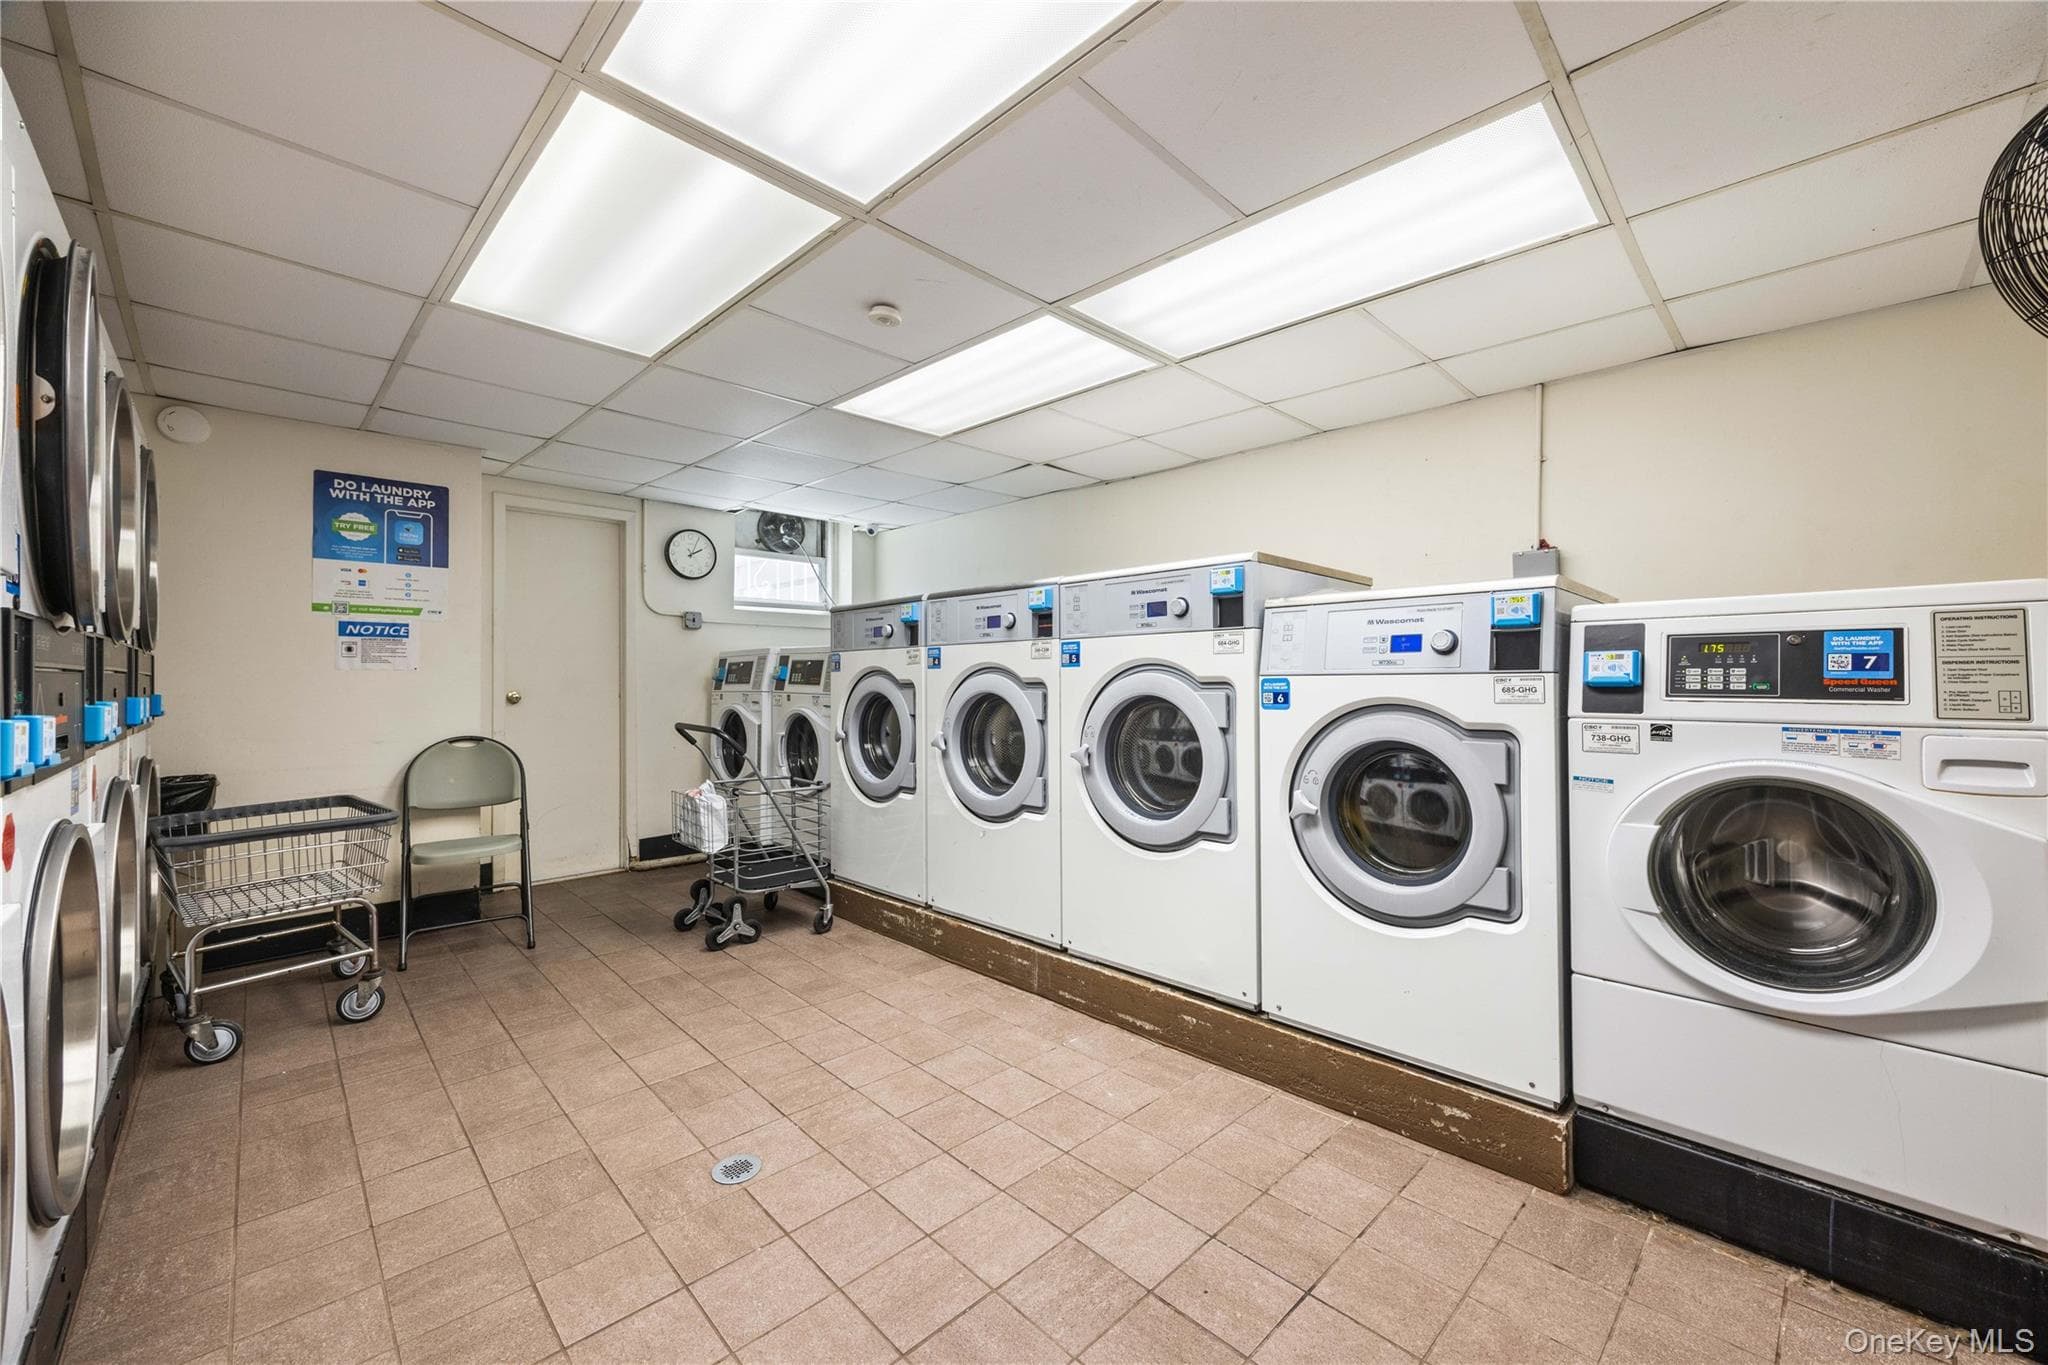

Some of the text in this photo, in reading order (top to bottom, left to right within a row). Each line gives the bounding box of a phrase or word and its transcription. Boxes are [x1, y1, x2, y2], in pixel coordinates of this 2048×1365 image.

[333, 479, 432, 499] DO LAUNDRY
[329, 488, 436, 509] WITH THE APP
[353, 524, 375, 532] FREE
[1375, 617, 1425, 625] Wascomat
[345, 625, 409, 636] NOTICE
[1863, 655, 1877, 669] 7
[1501, 686, 1538, 694] 685-GHG
[1277, 693, 1284, 703] 6
[1591, 734, 1632, 742] 738-GHG
